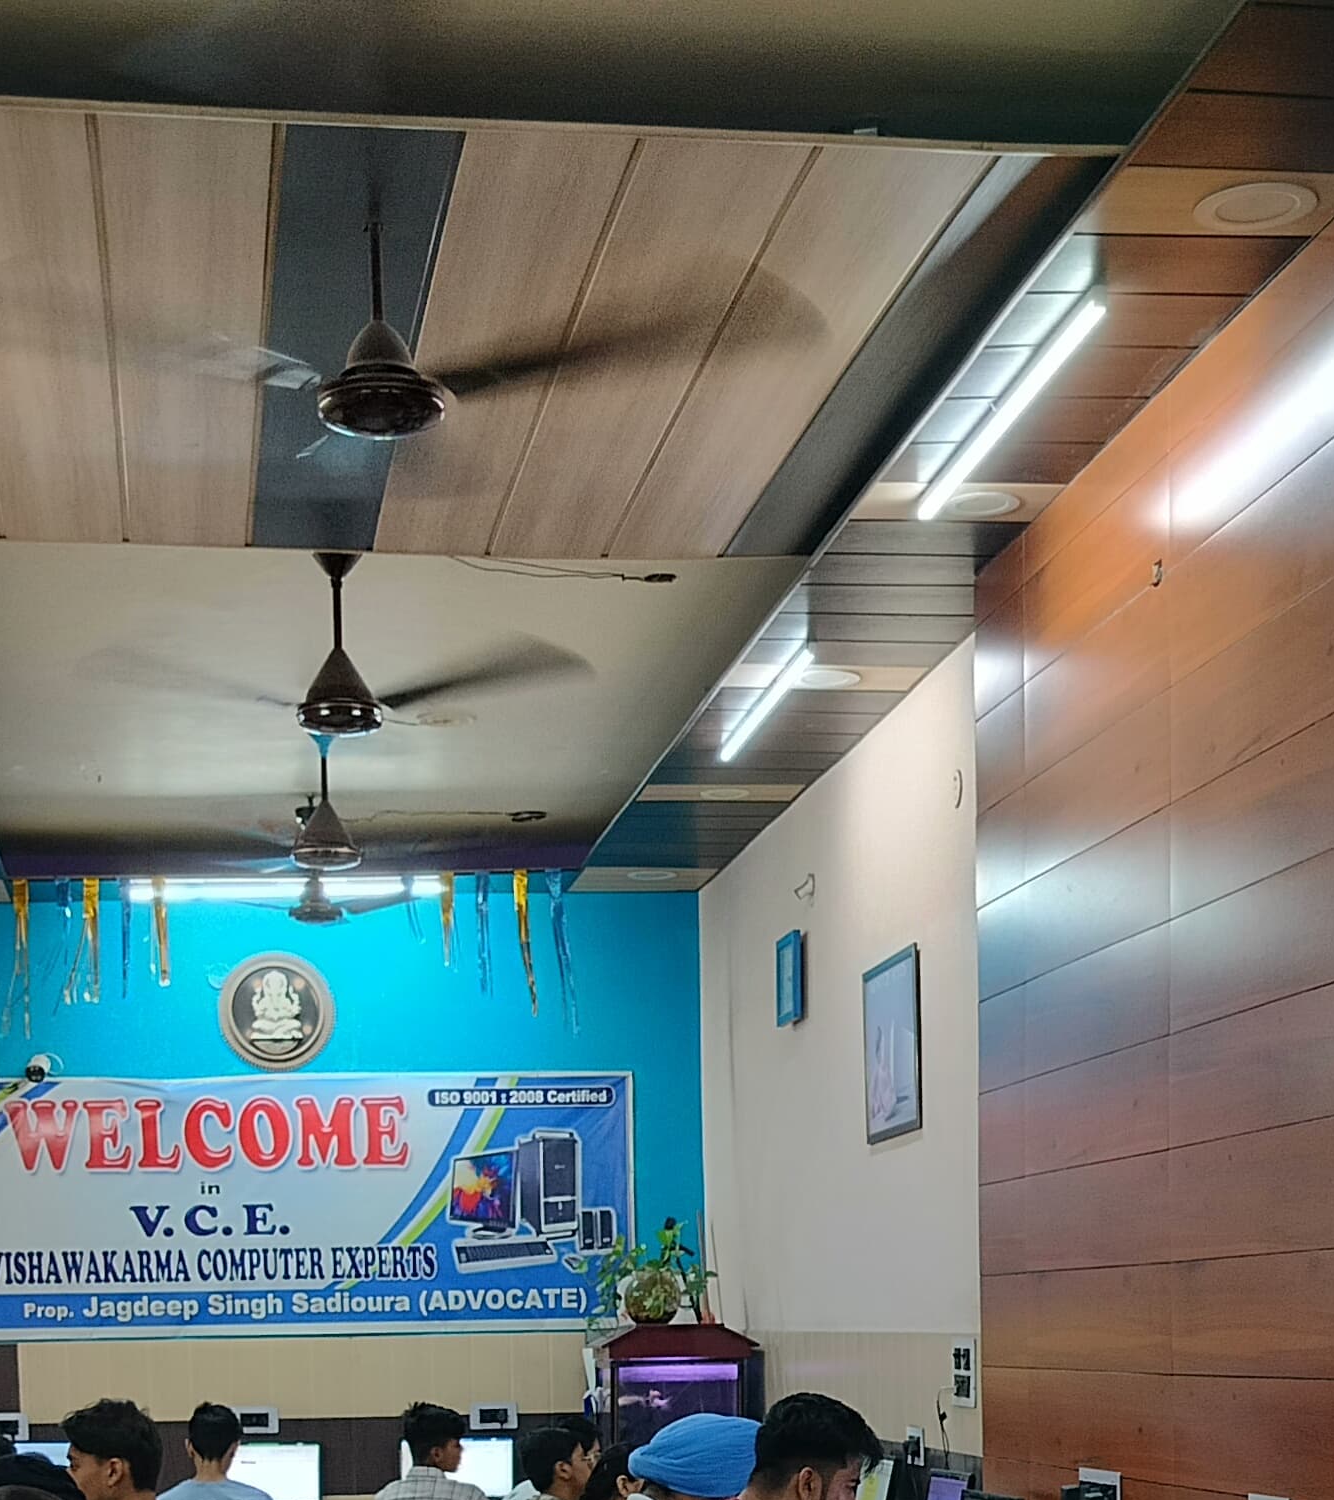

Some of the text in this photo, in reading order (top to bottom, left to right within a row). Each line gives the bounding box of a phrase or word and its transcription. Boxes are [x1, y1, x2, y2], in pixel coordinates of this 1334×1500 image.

[434, 1091, 460, 1105] ISO
[463, 1091, 497, 1103] 9001
[509, 1090, 544, 1103] 2008
[546, 1089, 607, 1103] Certified
[4, 1094, 410, 1172] WELCOME
[201, 1182, 220, 1194] in
[196, 1248, 325, 1284] COMPUTER
[331, 1244, 437, 1280] EXPERTS
[23, 1287, 588, 1324] Prop. Jagdeep Singh Sadioura (ADVOCATE)
